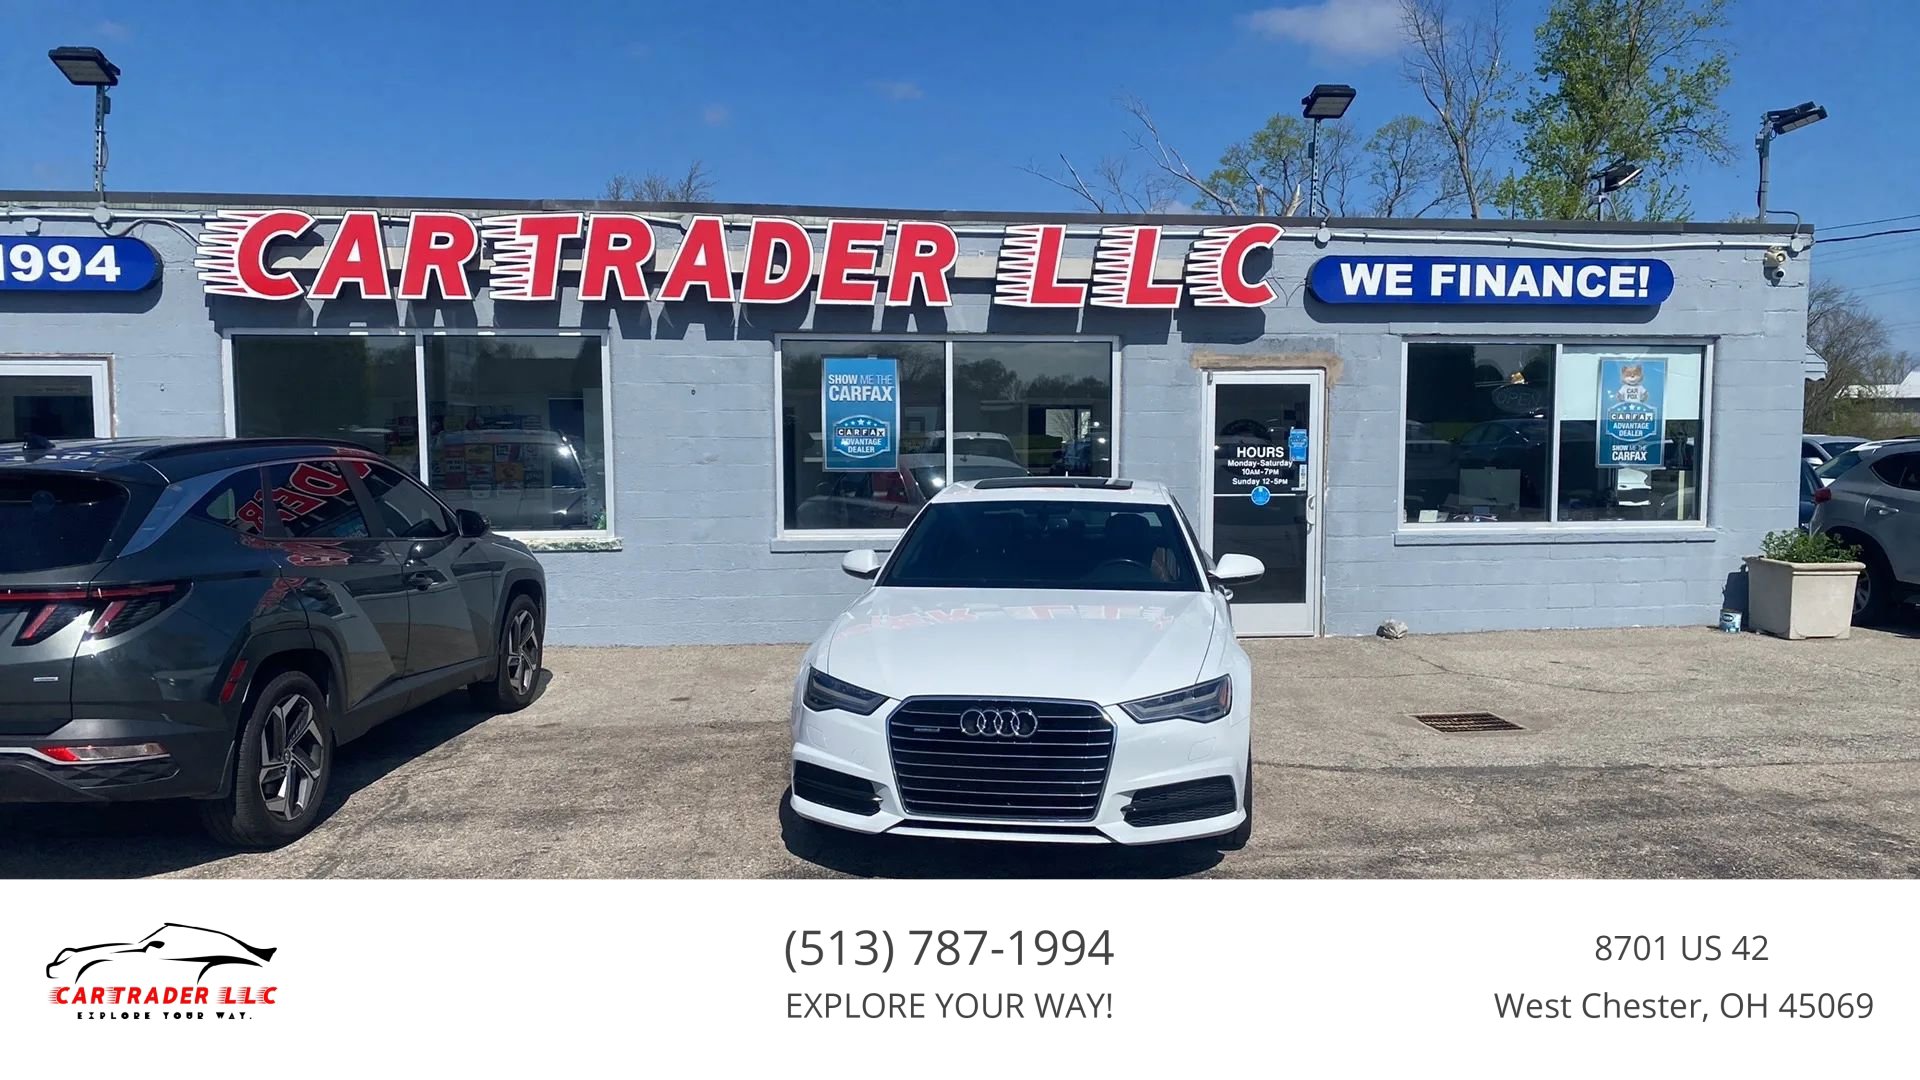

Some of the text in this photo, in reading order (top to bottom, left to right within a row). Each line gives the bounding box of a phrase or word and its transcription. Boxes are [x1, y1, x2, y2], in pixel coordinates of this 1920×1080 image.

[995, 223, 1284, 309] LLC
[1340, 263, 1650, 298] WE FINANCE!
[828, 374, 893, 385] SHOW ME THE
[828, 386, 893, 402] CARFAX
[1611, 413, 1653, 421] CARFAX
[1613, 422, 1650, 430] ADVANTAGE
[837, 428, 885, 437] CARFAX
[1618, 429, 1643, 437] DEALER
[841, 438, 882, 446] ADVANTAGE
[1236, 446, 1284, 458] HOURS
[1612, 451, 1648, 461] CARFAX
[1227, 459, 1293, 468] Monday-Saturday
[1232, 477, 1260, 486] Sunday
